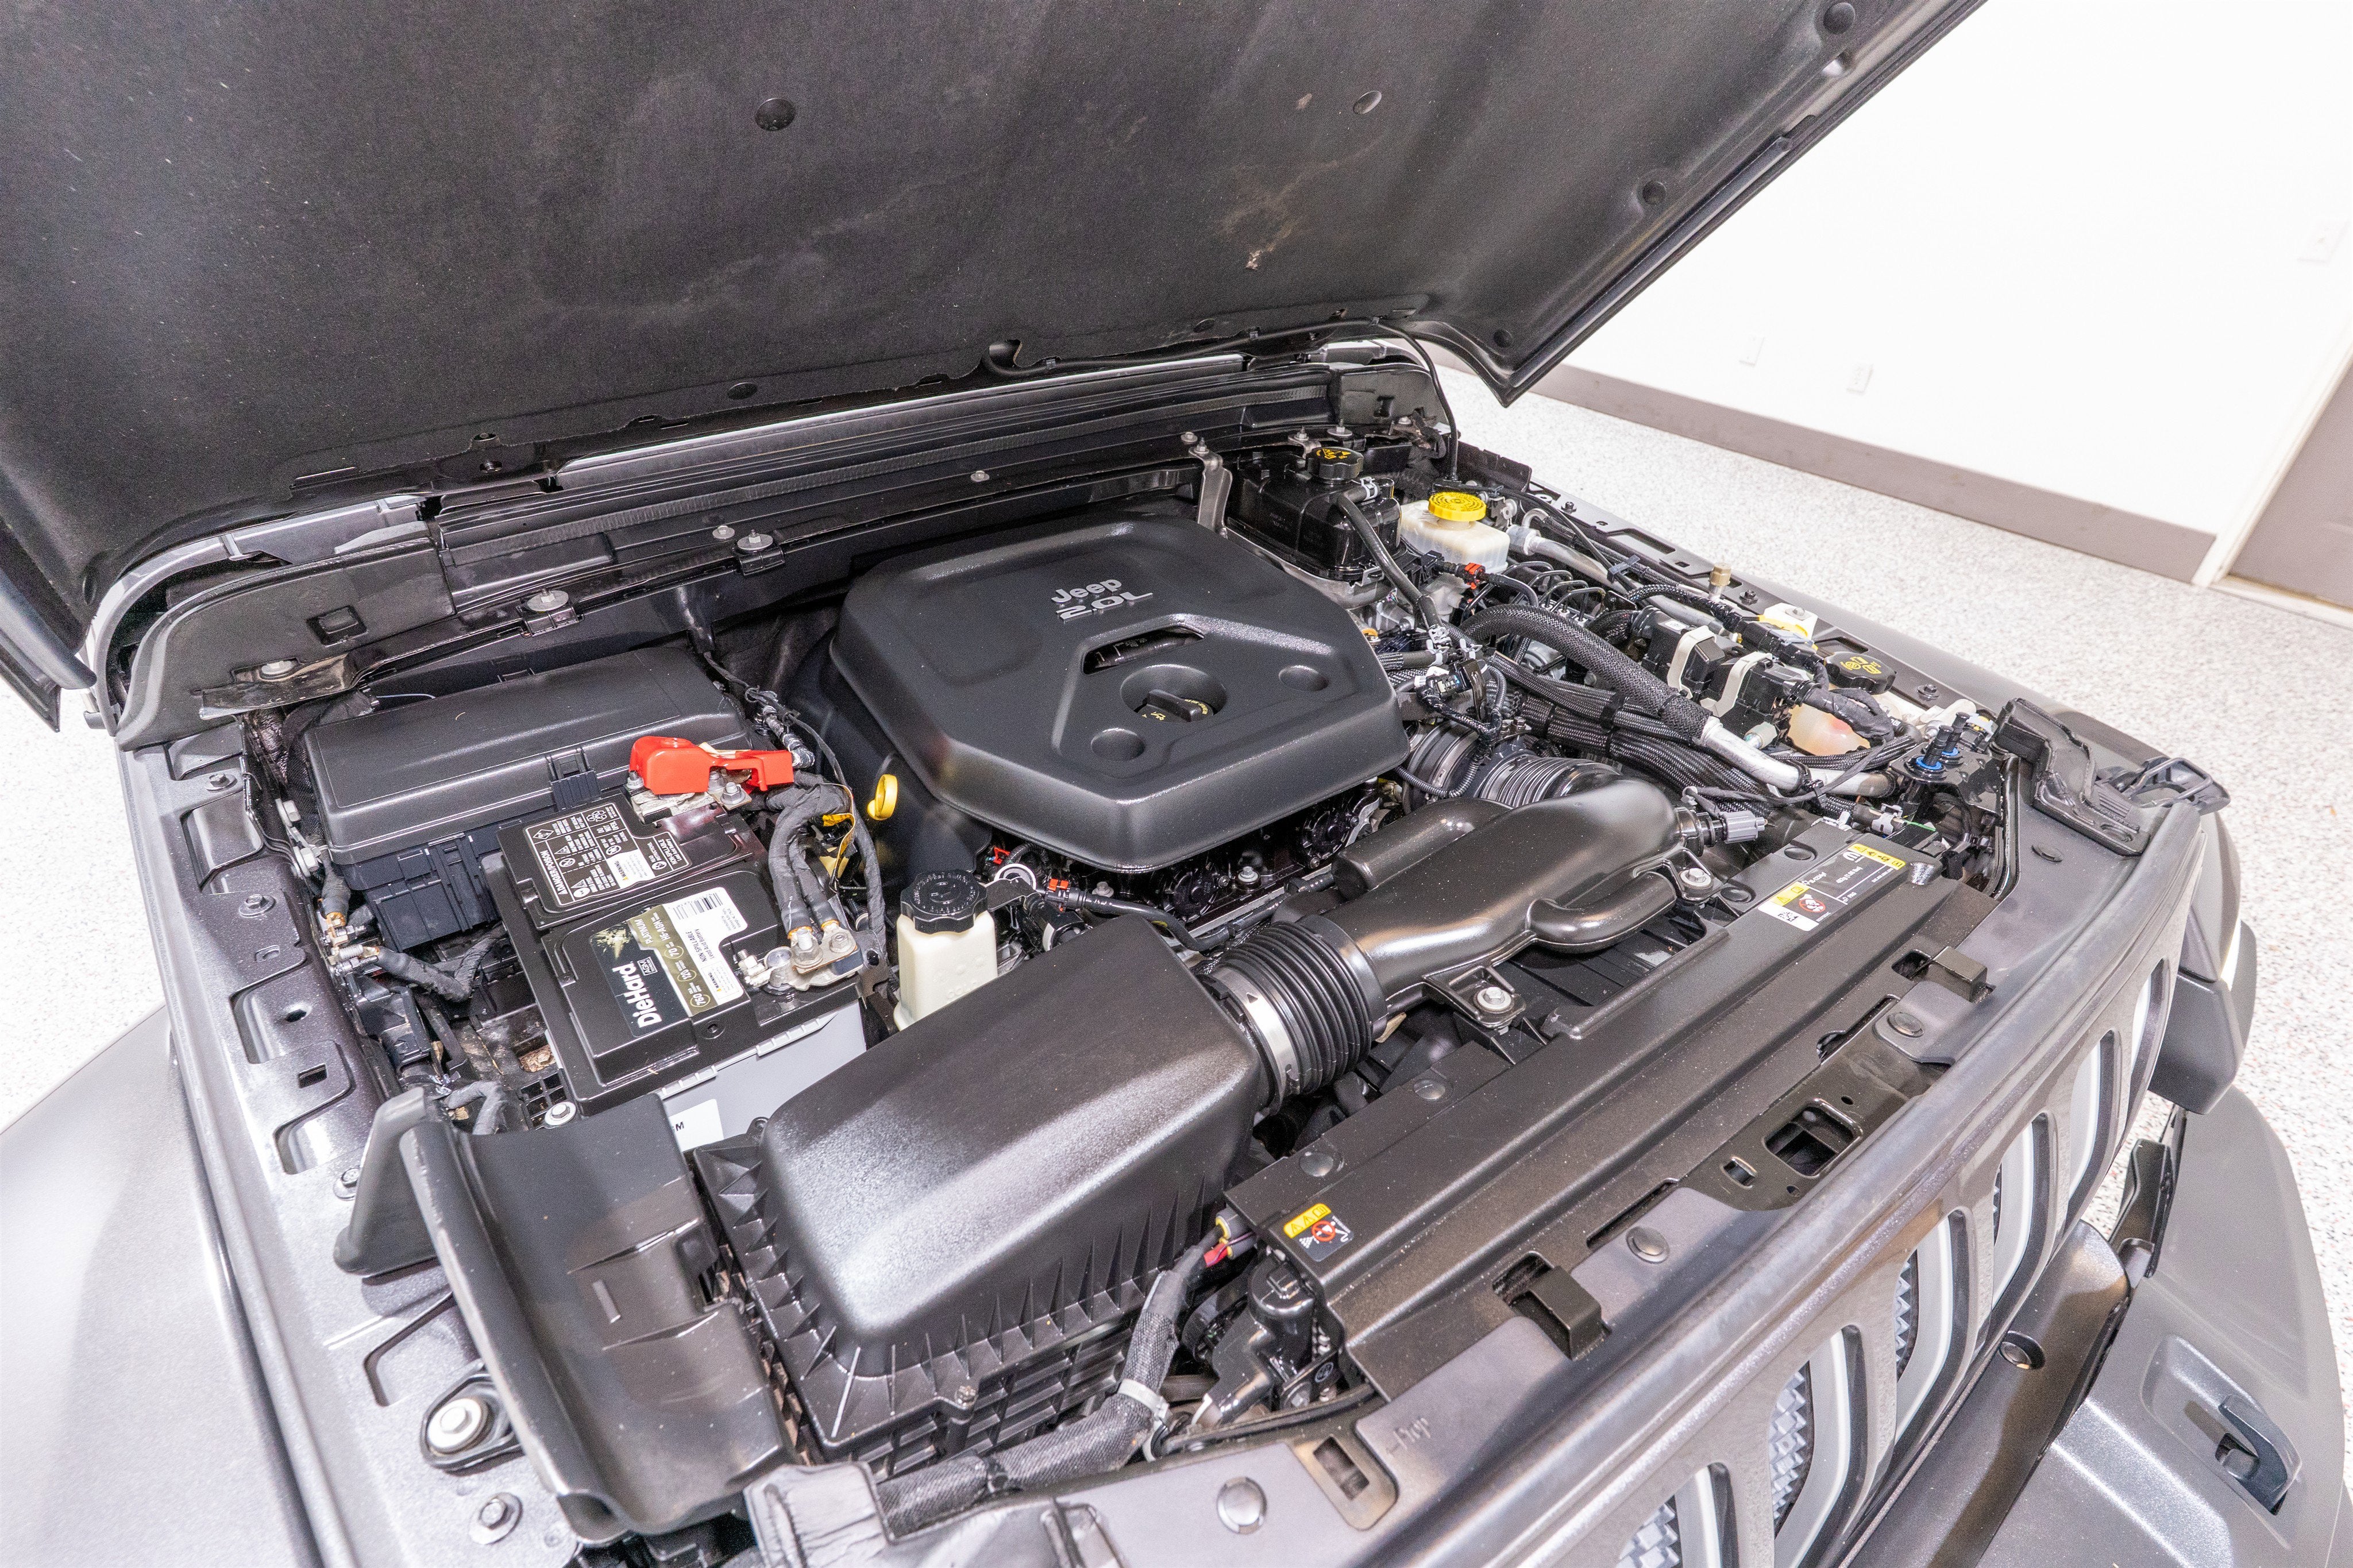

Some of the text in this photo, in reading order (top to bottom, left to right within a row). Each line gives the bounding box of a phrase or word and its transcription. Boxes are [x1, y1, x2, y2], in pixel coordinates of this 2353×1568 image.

[1051, 579, 1122, 603] Jeep
[1056, 593, 1153, 621] 2.0L
[634, 918, 653, 944] PLATINUM
[653, 919, 670, 941] H6-AGM
[668, 947, 680, 957] 70
[639, 960, 651, 974] AGM
[679, 968, 692, 980] 120
[611, 961, 662, 1028] DieHard
[692, 992, 706, 1006] 760
